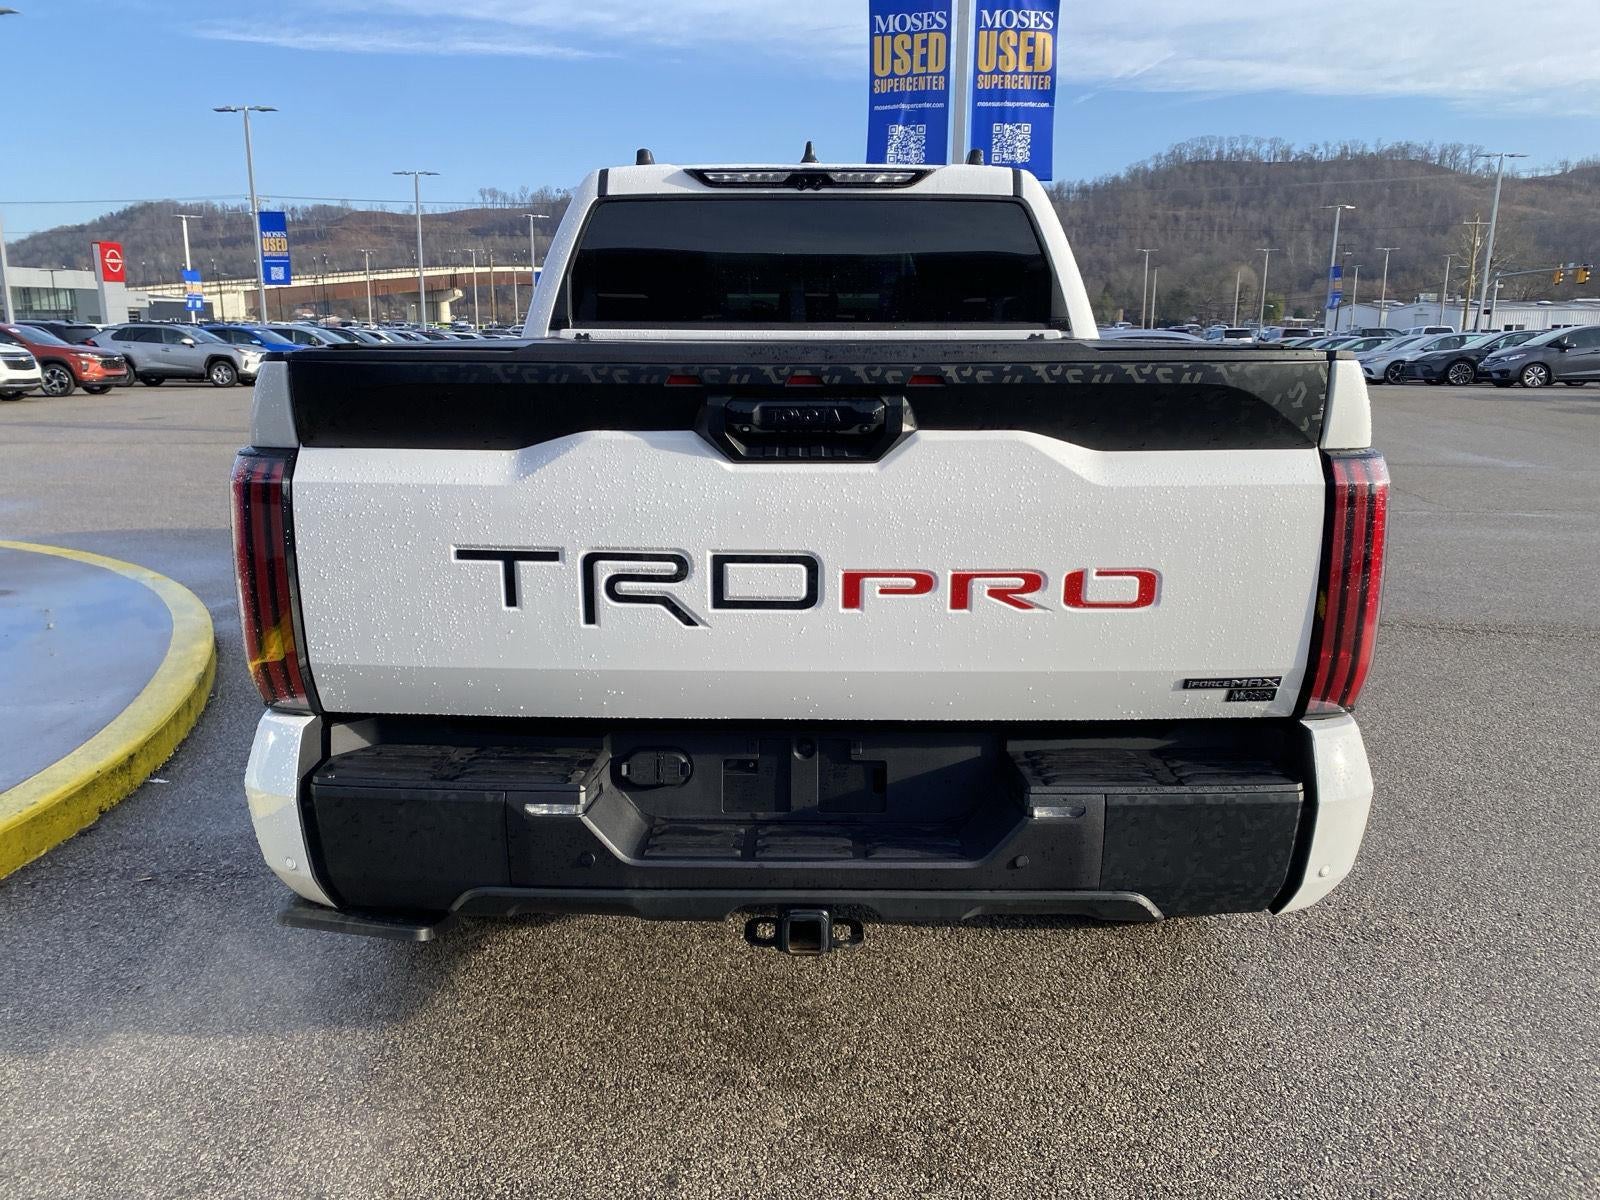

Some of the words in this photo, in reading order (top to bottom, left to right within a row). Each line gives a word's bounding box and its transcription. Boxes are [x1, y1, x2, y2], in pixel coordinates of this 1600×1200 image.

[874, 11, 947, 33] MOSES
[981, 9, 1054, 30] MOSES
[874, 32, 946, 77] USED
[978, 29, 1053, 73] USED
[874, 75, 945, 94] SUPERCENTER
[977, 74, 1051, 90] SUPERCENTER
[263, 238, 288, 251] USED
[456, 549, 821, 626] TRD
[841, 568, 1160, 610] PRO
